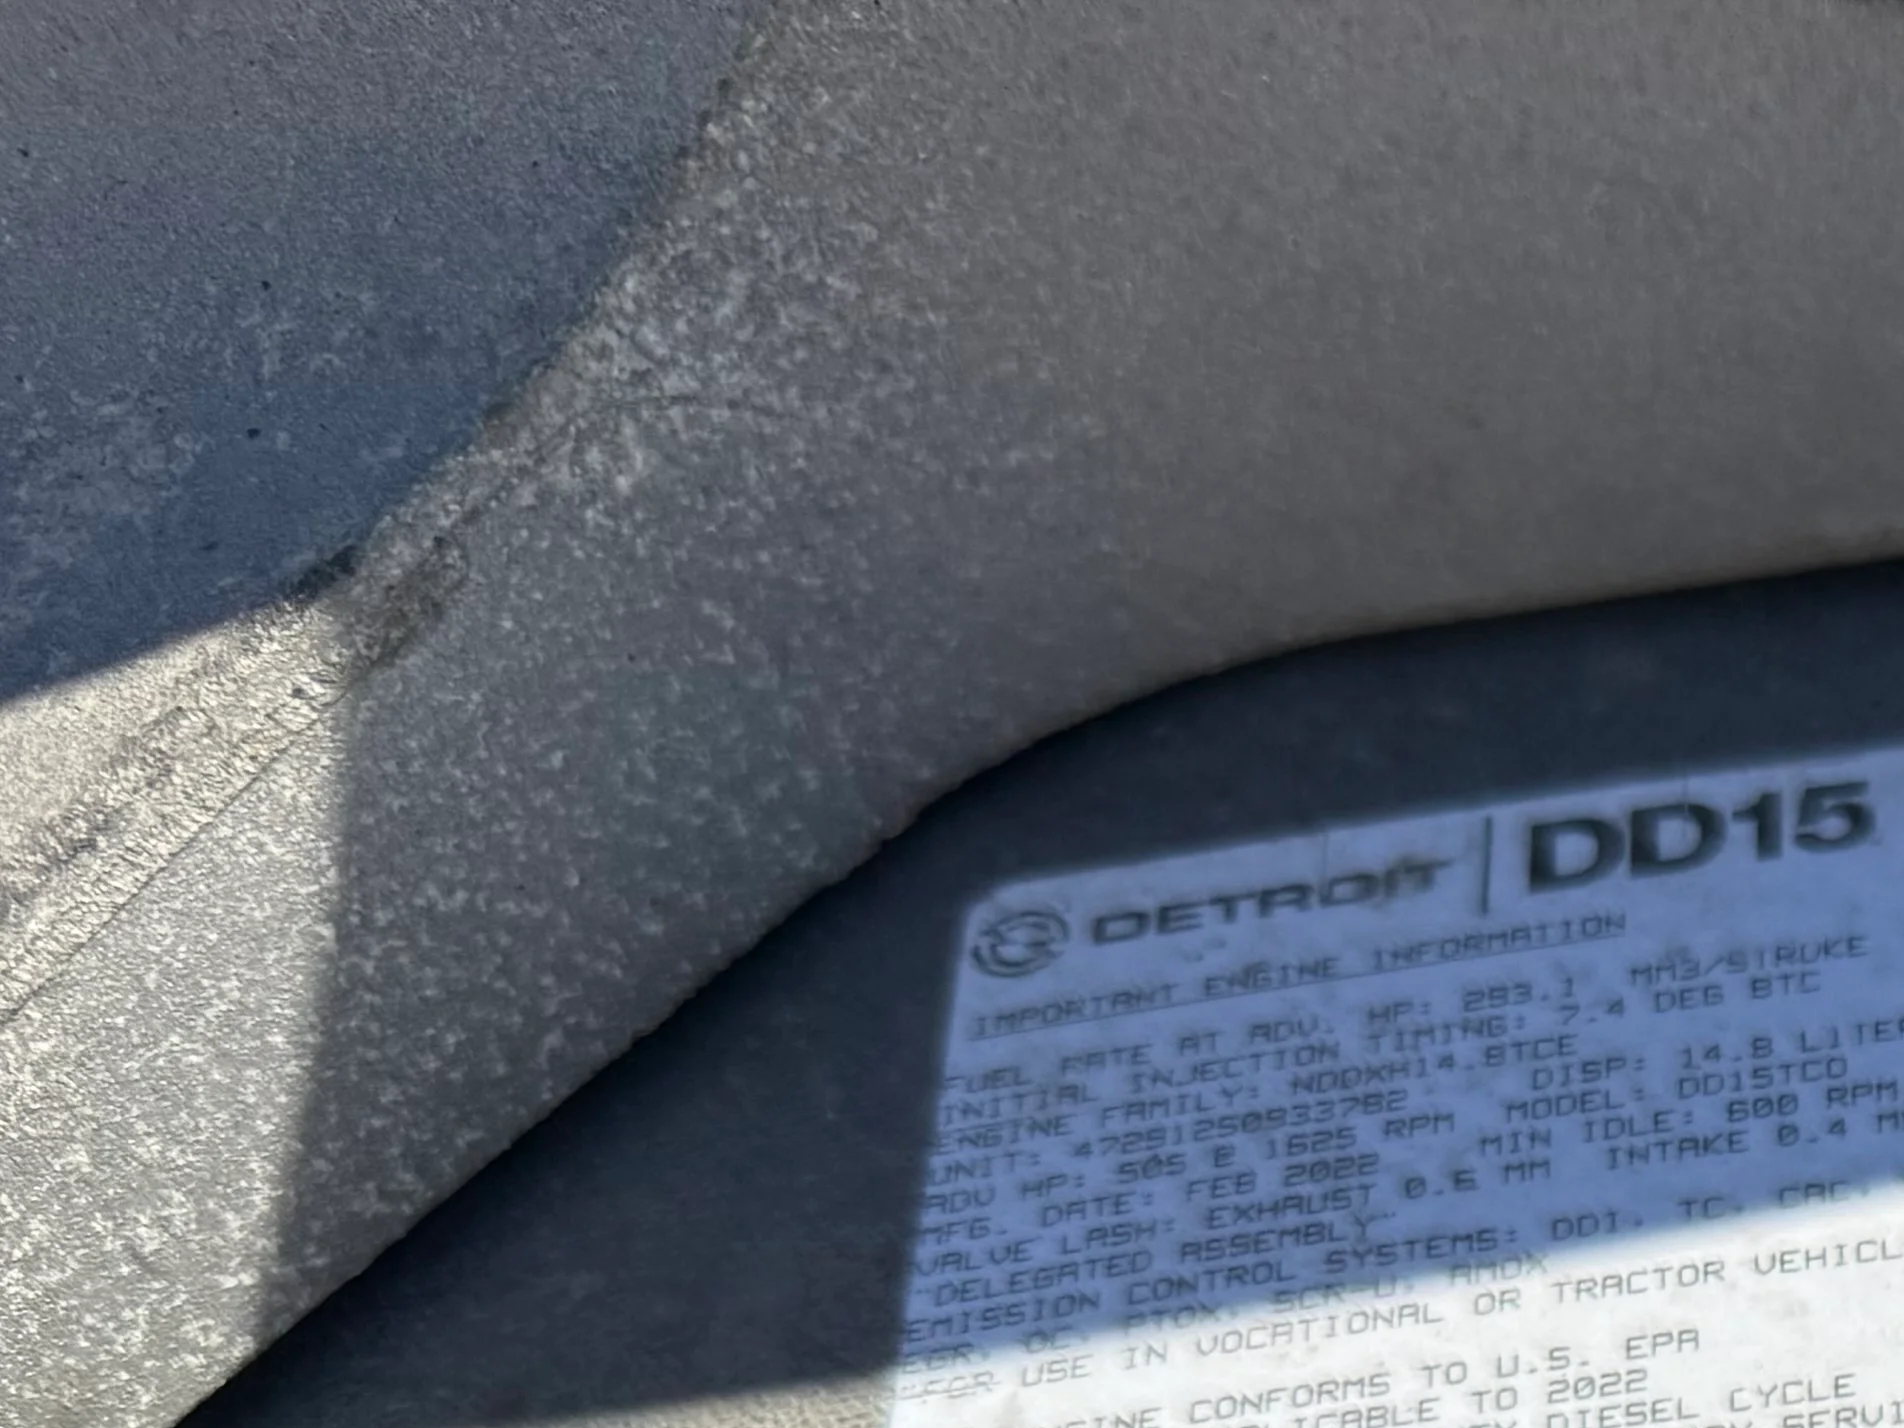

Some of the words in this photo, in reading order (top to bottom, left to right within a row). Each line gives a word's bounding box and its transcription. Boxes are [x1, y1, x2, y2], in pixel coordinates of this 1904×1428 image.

[1093, 857, 1452, 944] DETROIT
[1530, 780, 1875, 894] DD15
[972, 980, 1179, 1035] IMPORTANT
[1199, 956, 1344, 1001] ENGINE
[1369, 908, 1627, 971] INFORMATION
[944, 1078, 1100, 1126] INITIAL
[1128, 1038, 1341, 1095] INJECTION
[1365, 1009, 1526, 1057] TIMING:
[1555, 994, 1626, 1028] 7.4
[1652, 981, 1724, 1015] DEG
[1748, 968, 1821, 1002] BTC
[1055, 1041, 1153, 1078] RATE
[1174, 1027, 1223, 1057] AT
[1363, 995, 1432, 1028] HP:
[1530, 1050, 1646, 1092] DISP:
[1678, 1033, 1774, 1071] 14.8
[934, 1111, 1073, 1155] ENGINE
[1096, 1080, 1260, 1129] FAMILY:
[1015, 1168, 1087, 1203] HP:
[1381, 1108, 1456, 1143] RPM
[1502, 1081, 1646, 1127] MODEL:
[1037, 1187, 1155, 1229] DATE:
[1182, 1169, 1257, 1204] FEB
[1282, 1150, 1380, 1189] 2022
[1475, 1124, 1553, 1160] MIN
[1582, 1104, 1693, 1145] IDLE:
[1724, 1090, 1799, 1125] 600
[1825, 1076, 1899, 1111] RPM
[915, 1237, 1035, 1279] VALVE
[1057, 1214, 1176, 1256] LASH:
[1201, 1181, 1375, 1232] EXHAUST
[1499, 1155, 1552, 1187] MM
[1606, 1127, 1748, 1173] INTAKE
[1775, 1114, 1847, 1149] 0.4
[905, 1289, 1103, 1343] EMISSION
[1122, 1256, 1299, 1307] CONTROL
[1321, 1221, 1520, 1276] SYSTEMS:
[1019, 1353, 1093, 1389] USE
[1123, 1340, 1169, 1372] IN
[1193, 1297, 1445, 1360] VOCATIONAL
[1471, 1286, 1522, 1319] OR
[1550, 1256, 1726, 1308] TRACTOR
[1184, 1369, 1392, 1426] CONFORMS
[1415, 1358, 1469, 1391] TO
[1492, 1339, 1599, 1381] U.S.
[1623, 1325, 1701, 1362] EPA
[1467, 1383, 1519, 1417] TO
[1545, 1365, 1648, 1406] 2022
[1727, 1369, 1856, 1415] CYCLE
